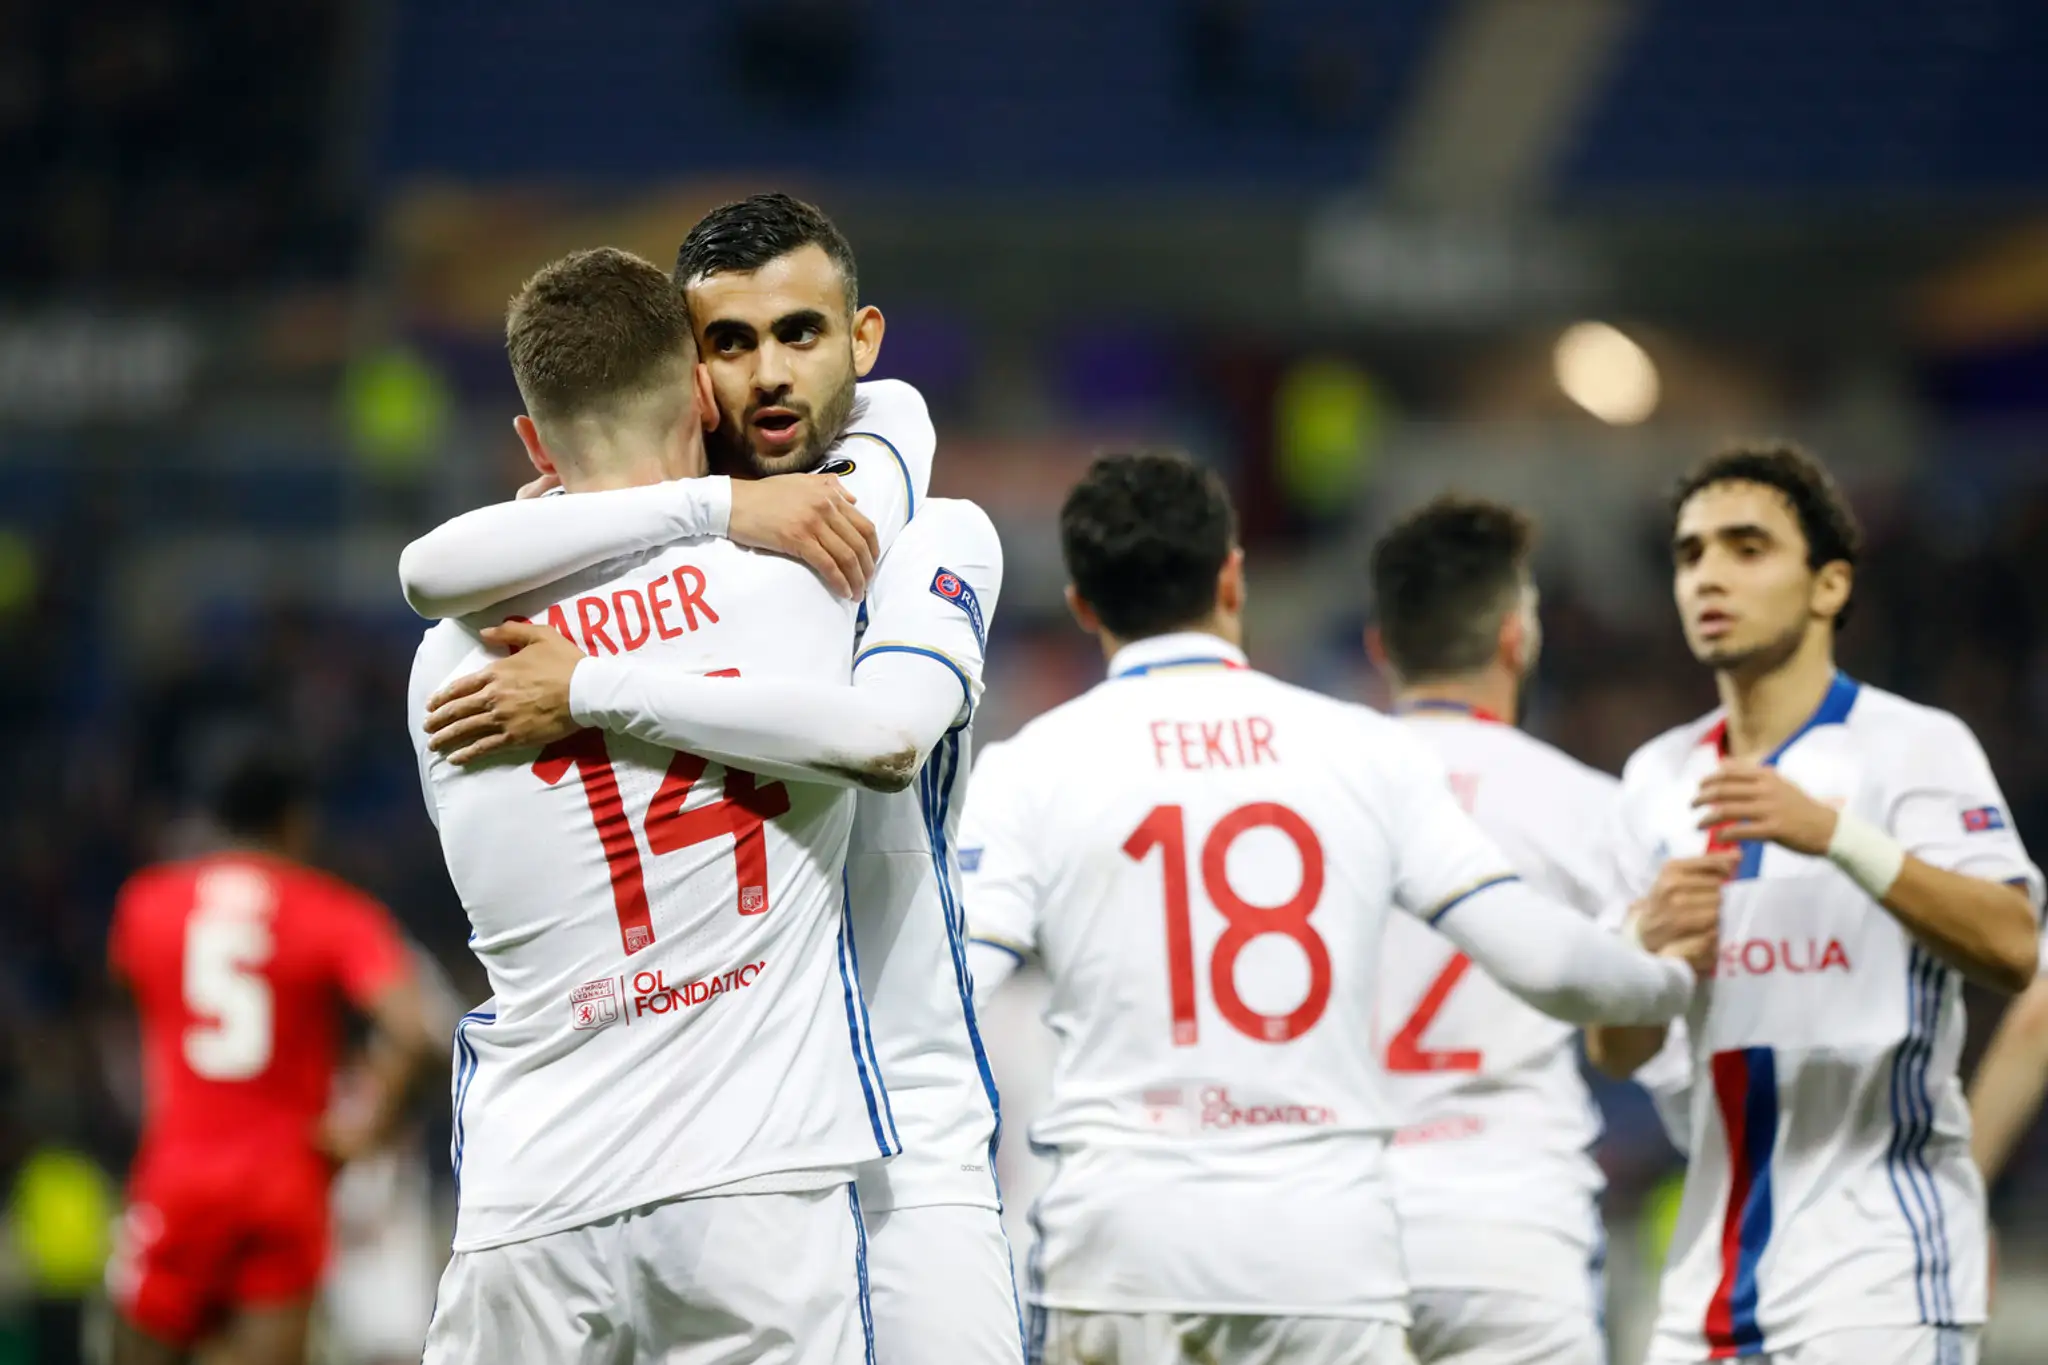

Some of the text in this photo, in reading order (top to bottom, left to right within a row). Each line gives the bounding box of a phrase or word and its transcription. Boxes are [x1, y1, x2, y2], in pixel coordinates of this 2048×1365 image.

[503, 565, 720, 658] ARDER
[1149, 715, 1280, 771] FEKIR
[531, 668, 790, 956] 14
[1121, 801, 1333, 1046] 18
[1709, 936, 1852, 978] EOLIA
[183, 914, 276, 1081] 5
[633, 970, 671, 995] OL
